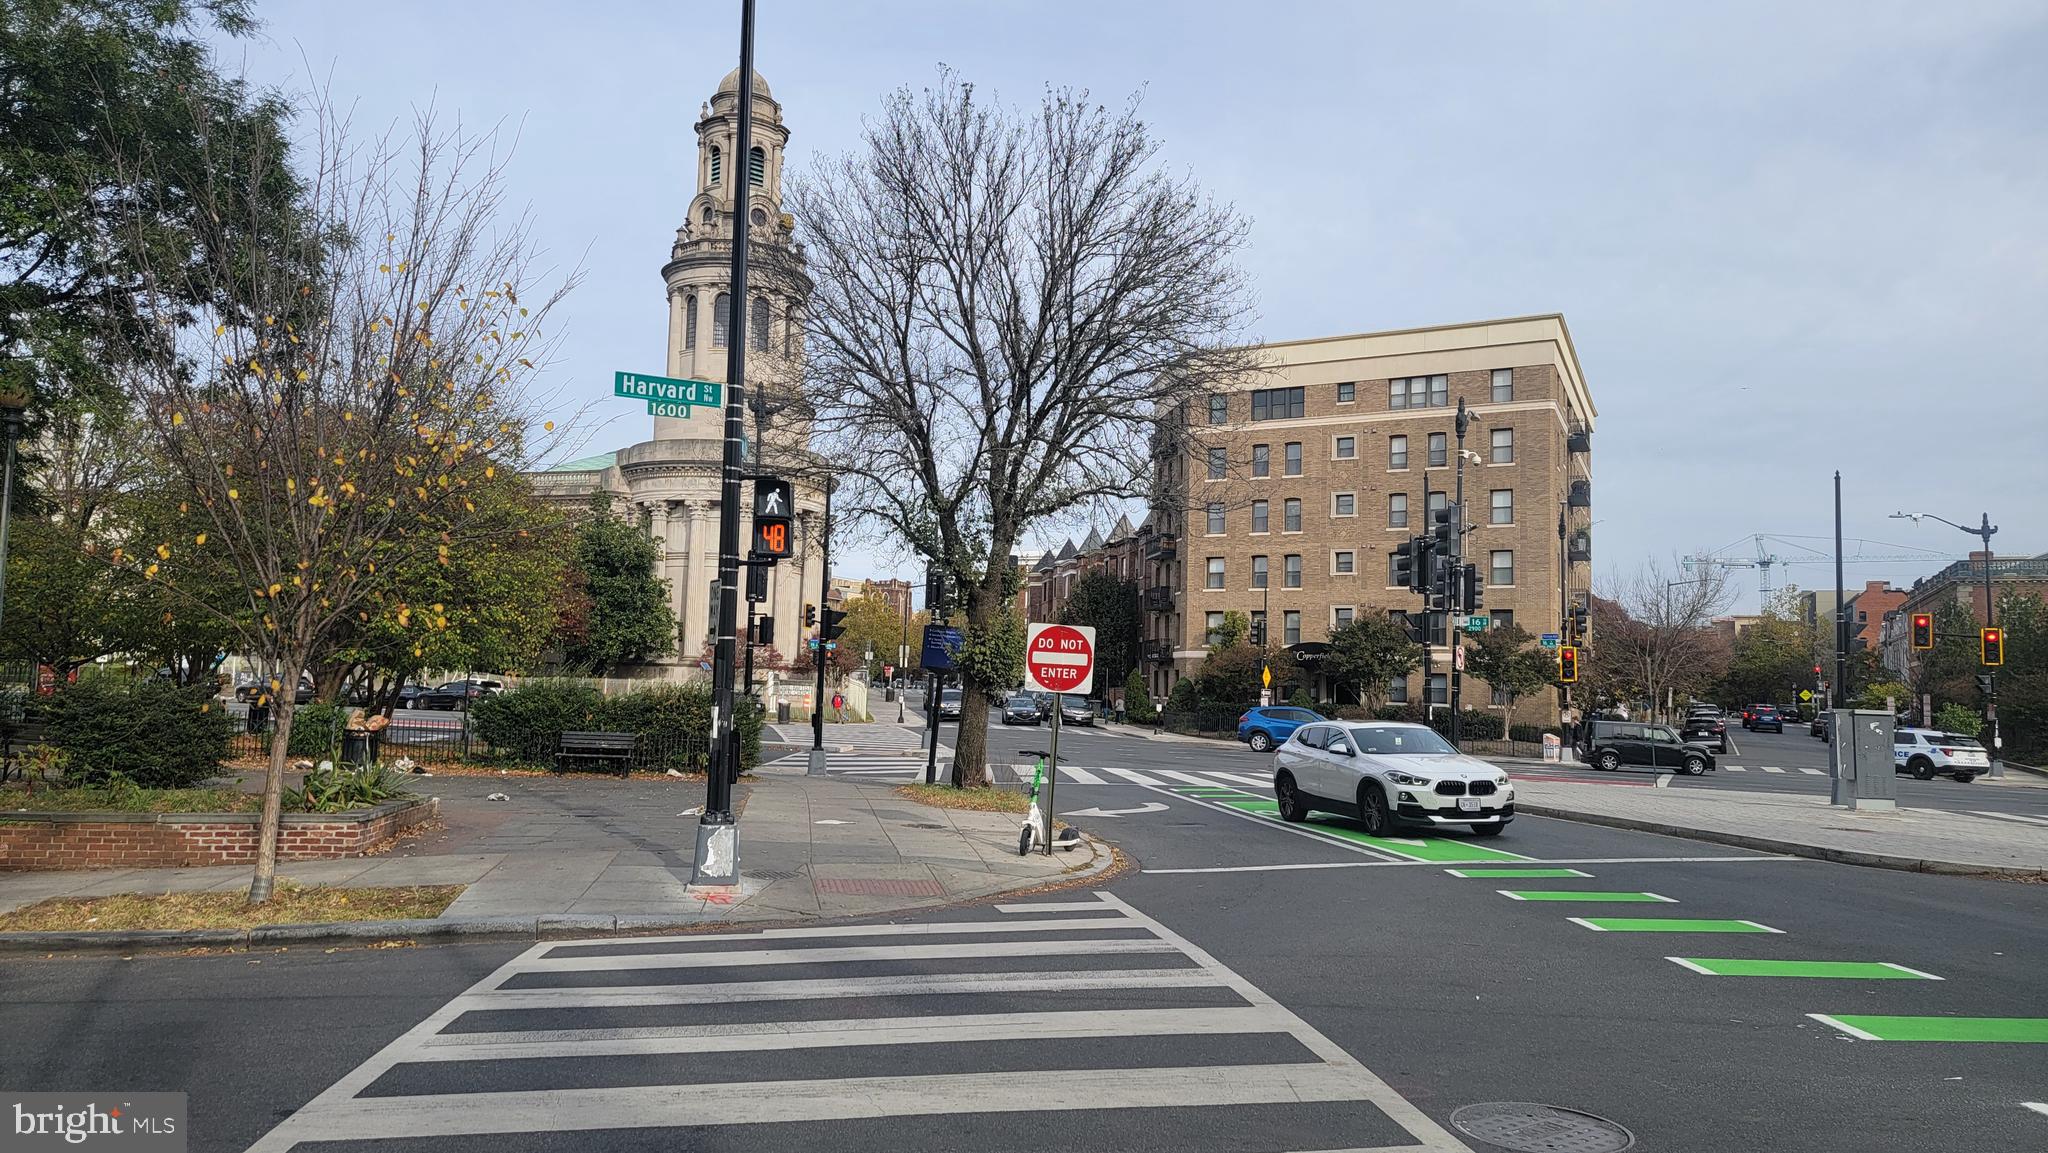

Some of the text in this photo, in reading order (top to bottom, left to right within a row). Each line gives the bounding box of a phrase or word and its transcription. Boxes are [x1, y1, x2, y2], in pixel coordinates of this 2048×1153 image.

[622, 374, 697, 401] Harvard
[703, 384, 713, 394] St
[651, 402, 687, 418] 1600
[763, 523, 785, 553] 48
[1471, 618, 1481, 626] 16
[1038, 637, 1084, 651] DO NOT
[1296, 650, 1331, 661] Copperfiel
[1040, 667, 1078, 680] ENTER
